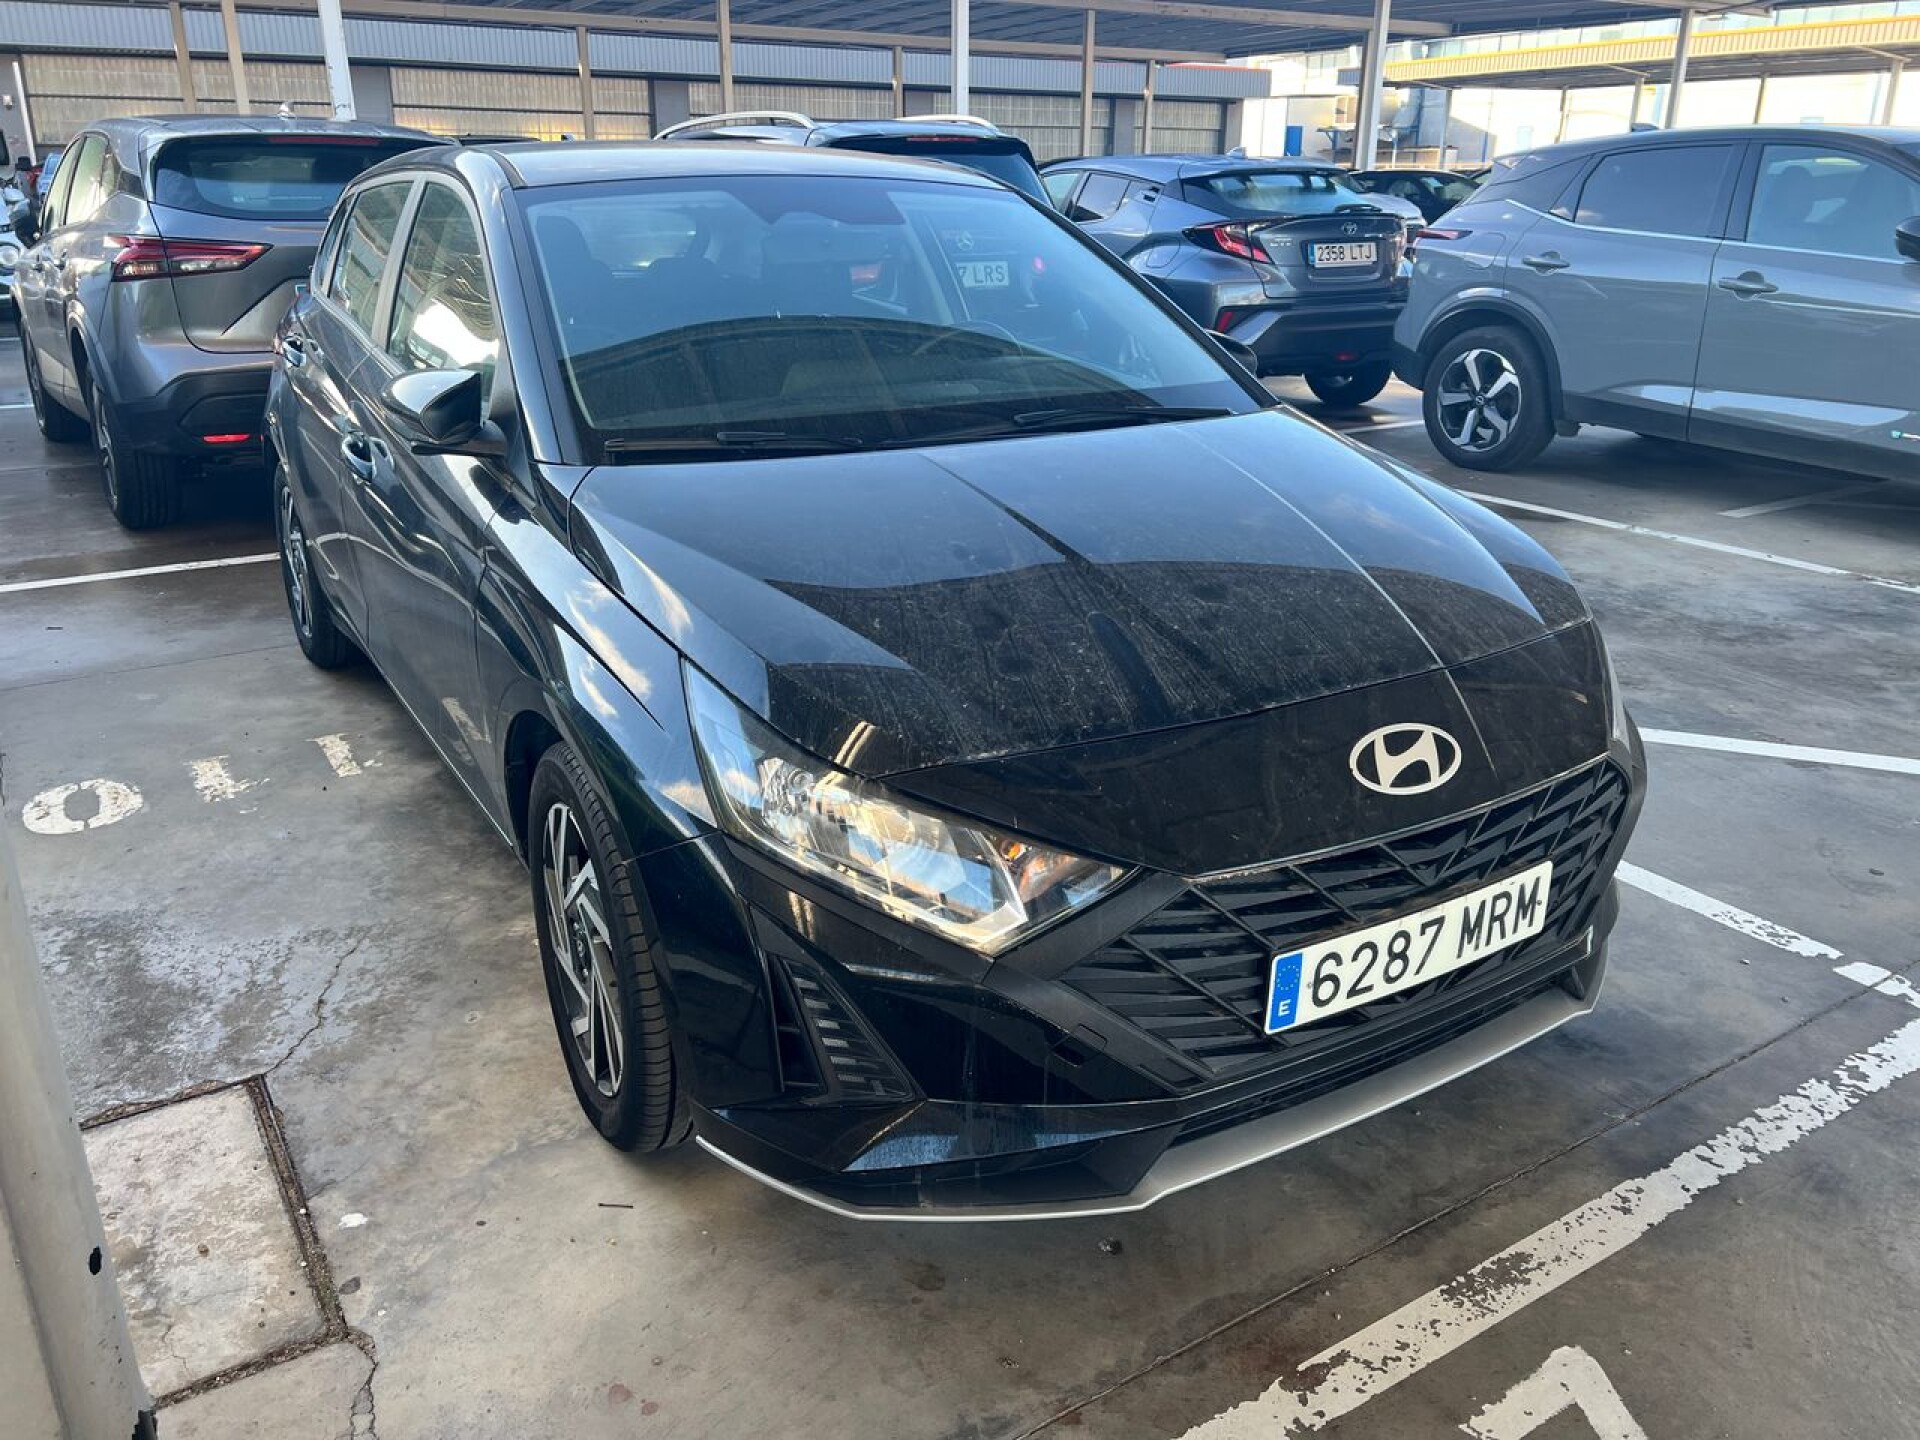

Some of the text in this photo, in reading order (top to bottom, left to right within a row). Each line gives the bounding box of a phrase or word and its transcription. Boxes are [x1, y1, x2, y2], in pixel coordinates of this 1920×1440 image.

[1317, 244, 1345, 262] 2358
[1350, 243, 1372, 260] LTJ
[973, 264, 1006, 284] LRS
[1310, 875, 1542, 1009] 6287 MRM
[1277, 997, 1291, 1017] E
